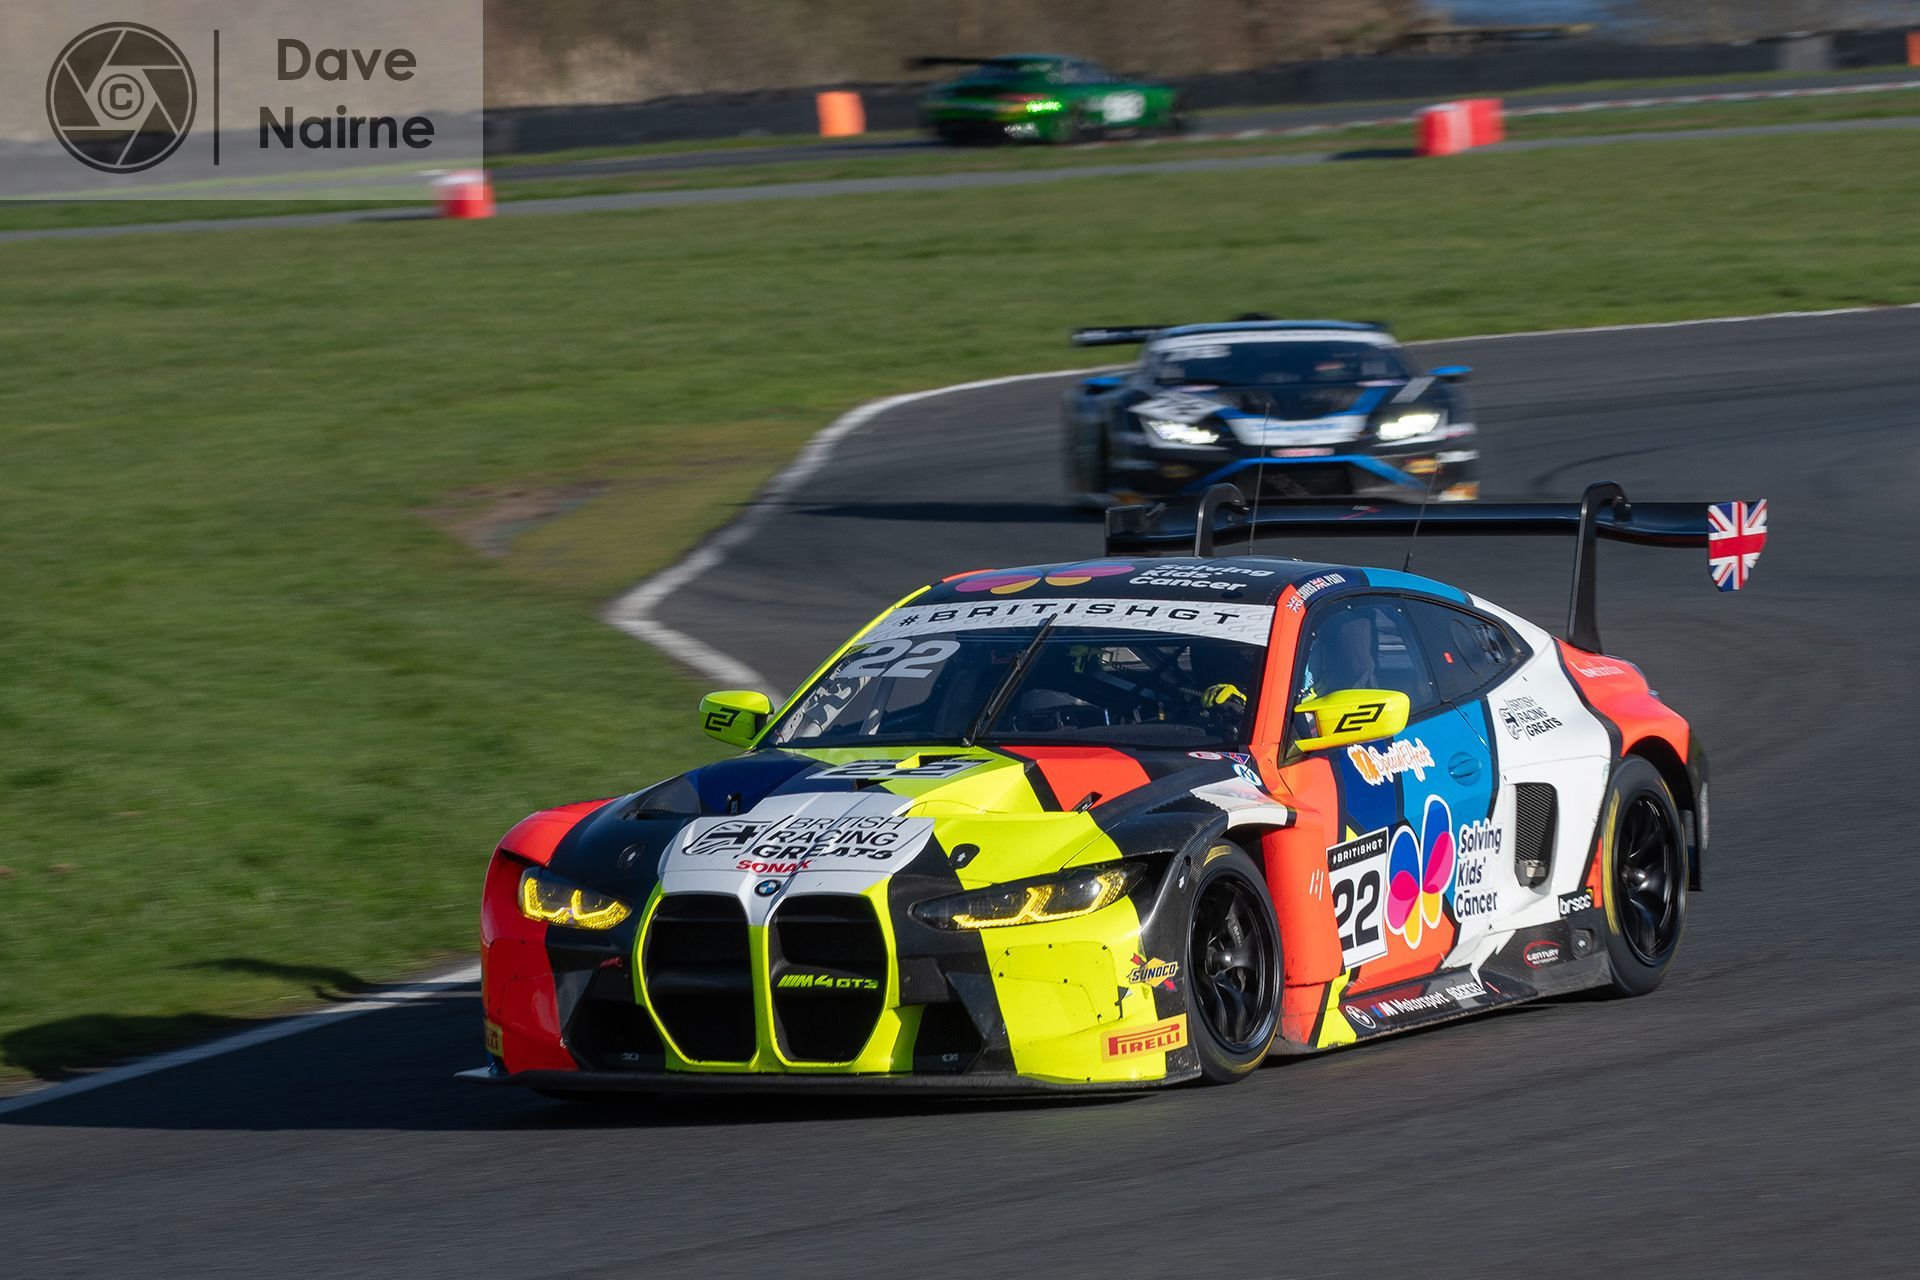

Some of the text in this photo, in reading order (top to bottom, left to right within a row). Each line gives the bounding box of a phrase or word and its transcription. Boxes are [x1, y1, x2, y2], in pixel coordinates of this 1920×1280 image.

[1155, 564, 1275, 577] Solving
[1129, 576, 1247, 591] Cancer
[900, 603, 1240, 626] #BRITISHGT
[839, 639, 961, 678] 22
[1526, 717, 1563, 737] GREATS
[785, 816, 906, 830] BRITISH
[766, 830, 899, 846] RACING
[1460, 823, 1502, 854] Solving
[751, 844, 893, 860] GREATS
[1332, 838, 1383, 865] #BRITISHGT
[1332, 869, 1380, 951] 22
[1132, 963, 1177, 982] SUNOCO
[1393, 991, 1450, 1015] Motorsport
[1108, 1023, 1180, 1056] PIRELLI
